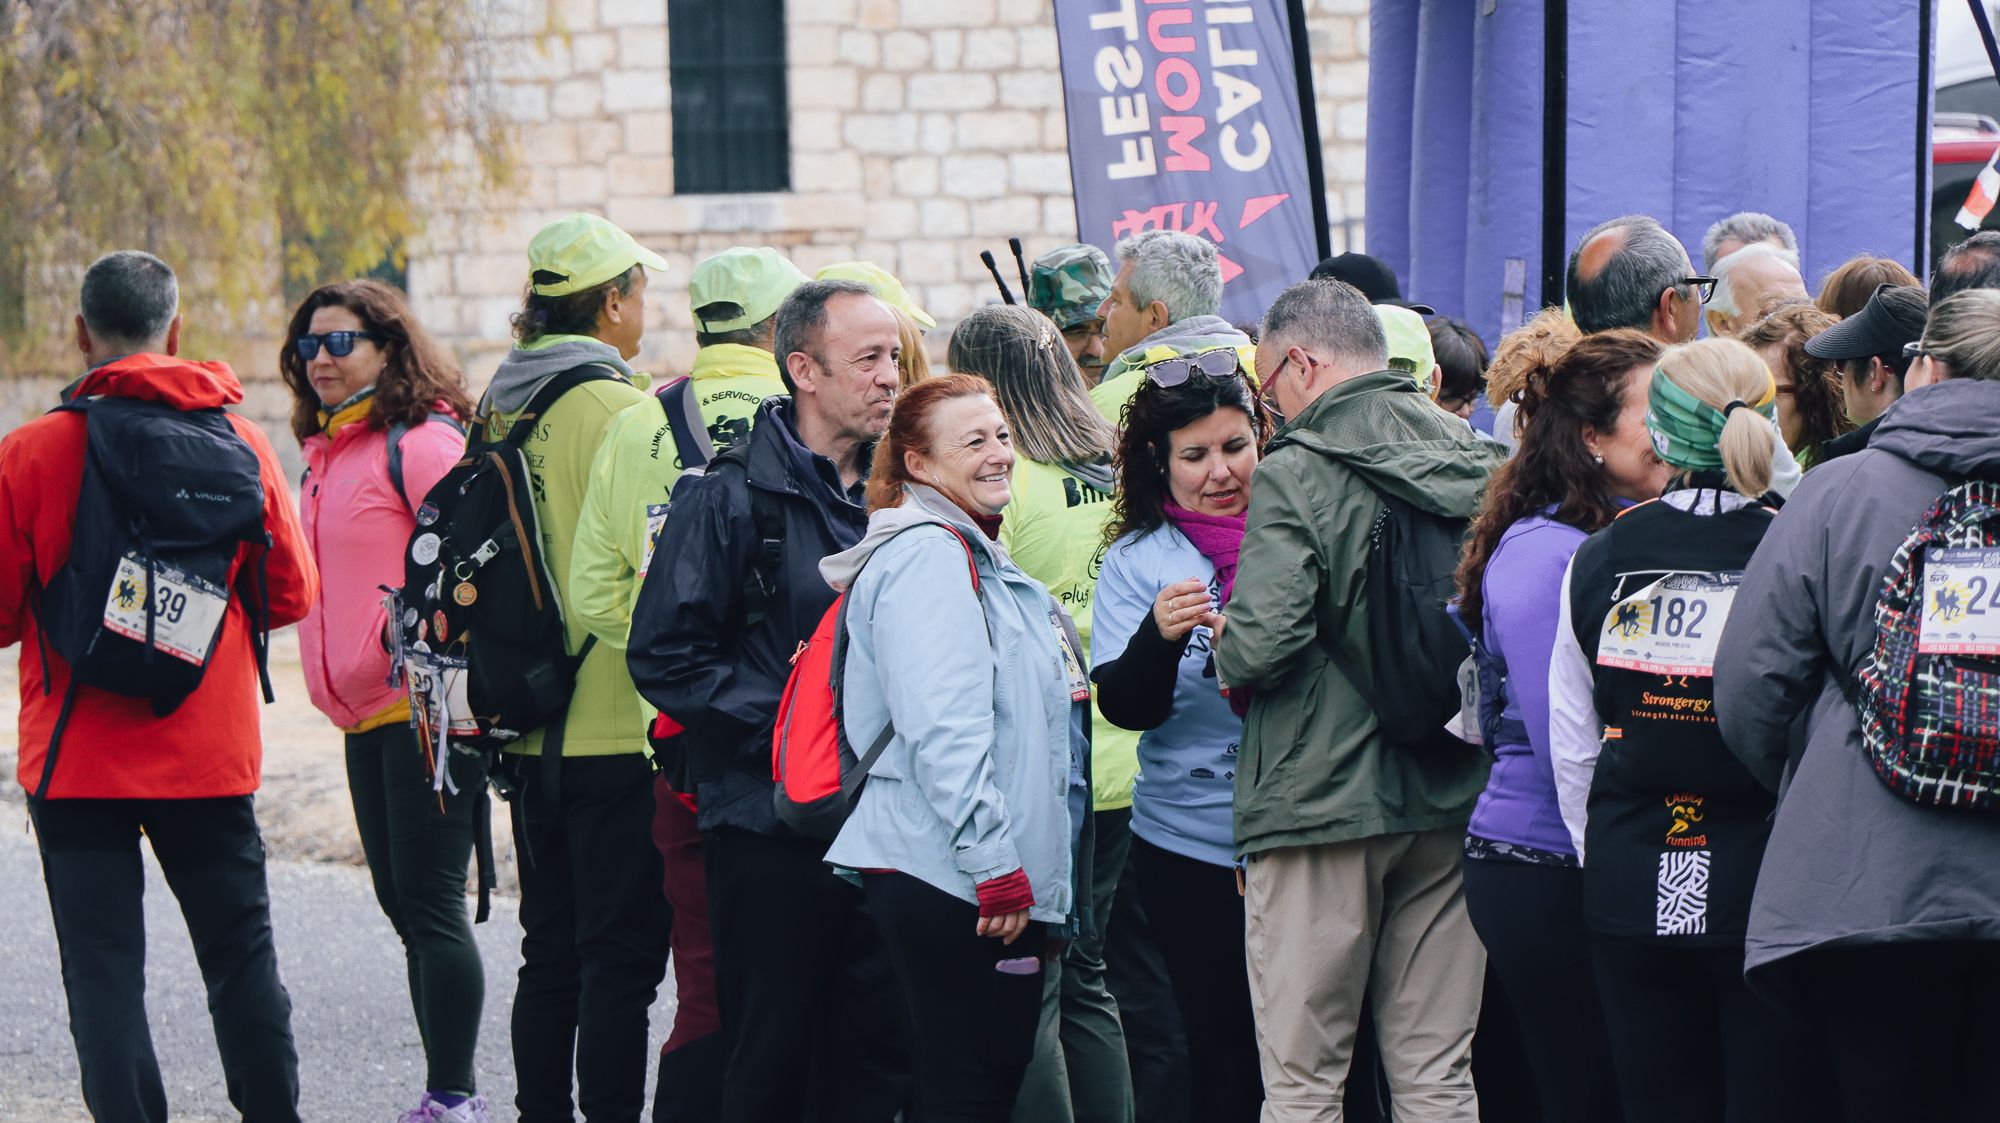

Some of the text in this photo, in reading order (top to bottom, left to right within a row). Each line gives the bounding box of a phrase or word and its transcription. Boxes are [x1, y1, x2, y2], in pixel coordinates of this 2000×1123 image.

[141, 586, 187, 624] 39
[1650, 595, 1708, 639] 182
[1641, 691, 1711, 712] Strongergy
[1666, 834, 1707, 847] running
